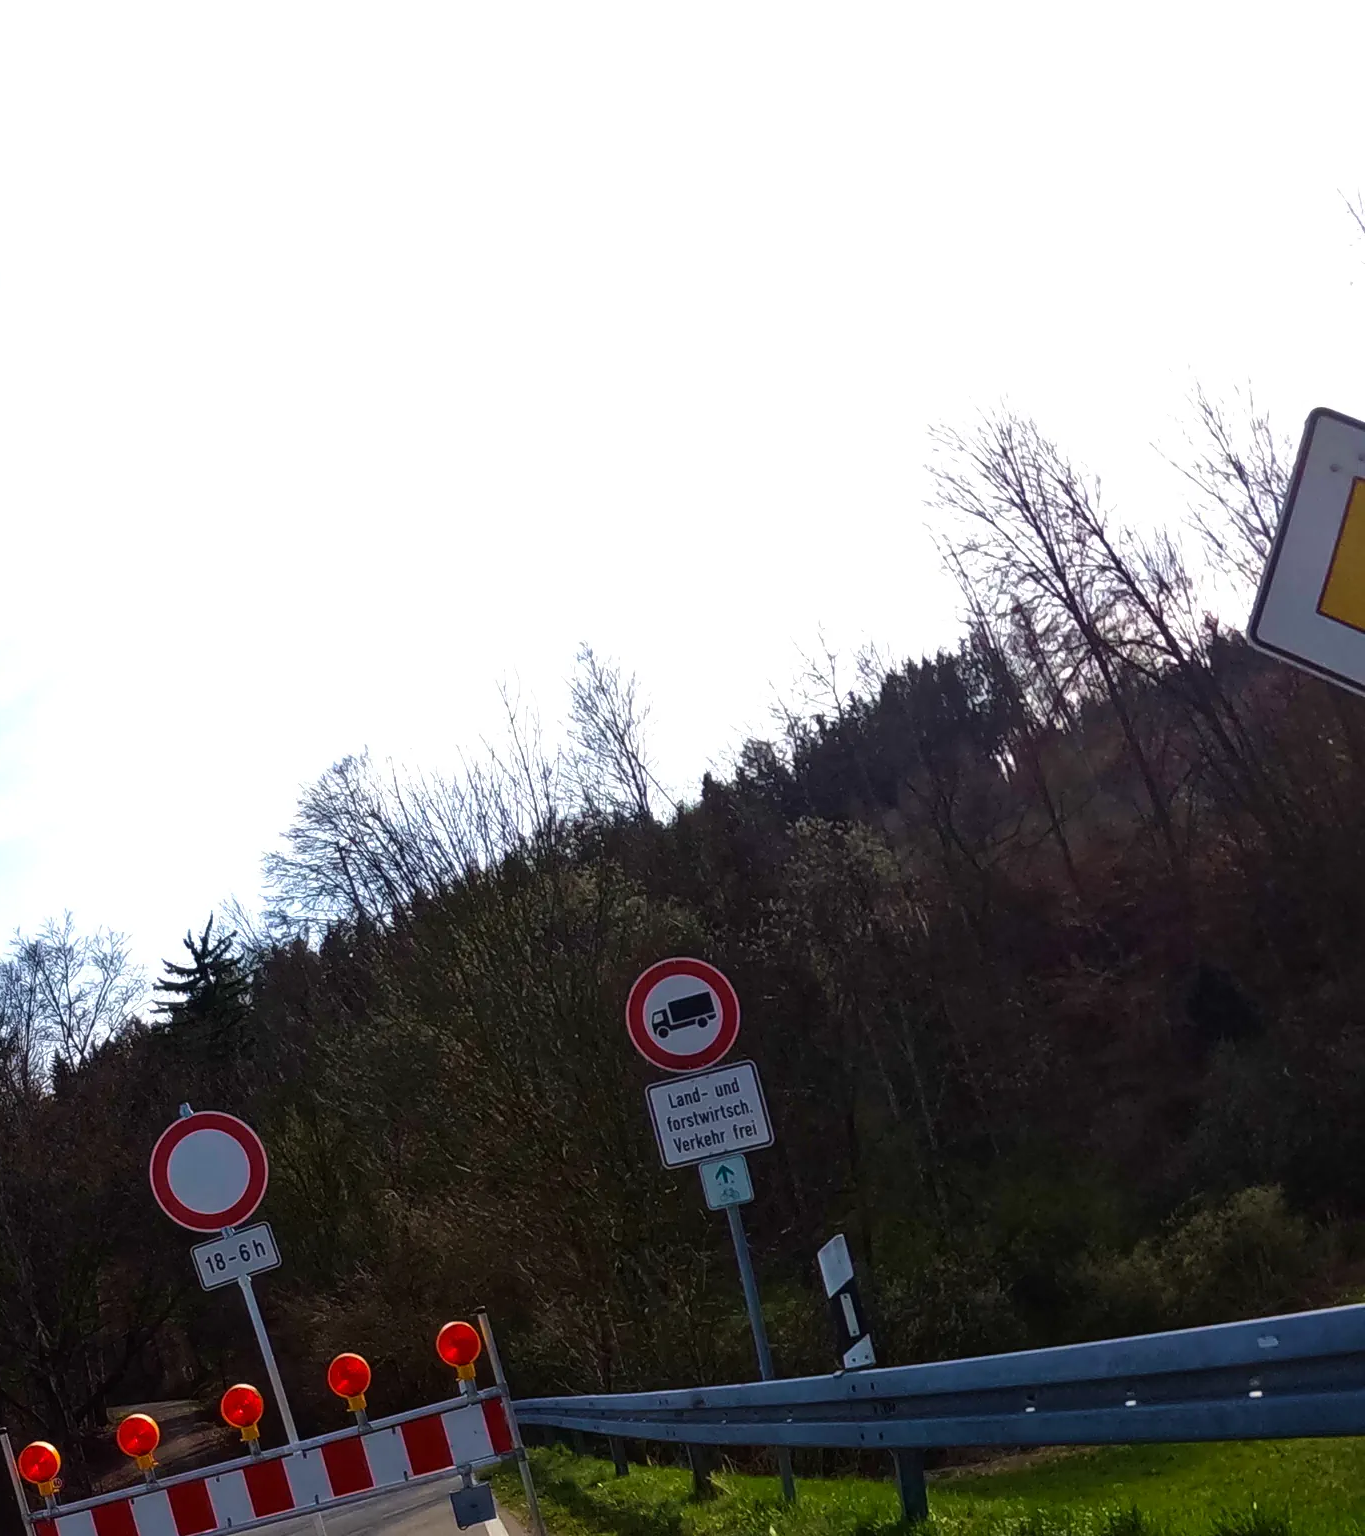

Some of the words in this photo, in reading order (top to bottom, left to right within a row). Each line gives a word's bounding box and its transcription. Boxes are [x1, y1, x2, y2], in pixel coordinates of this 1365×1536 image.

[668, 1087, 709, 1109] Land-
[715, 1077, 740, 1098] und
[667, 1100, 754, 1132] forstwirtsch.
[673, 1130, 727, 1153] Verkehr
[733, 1119, 758, 1140] frei
